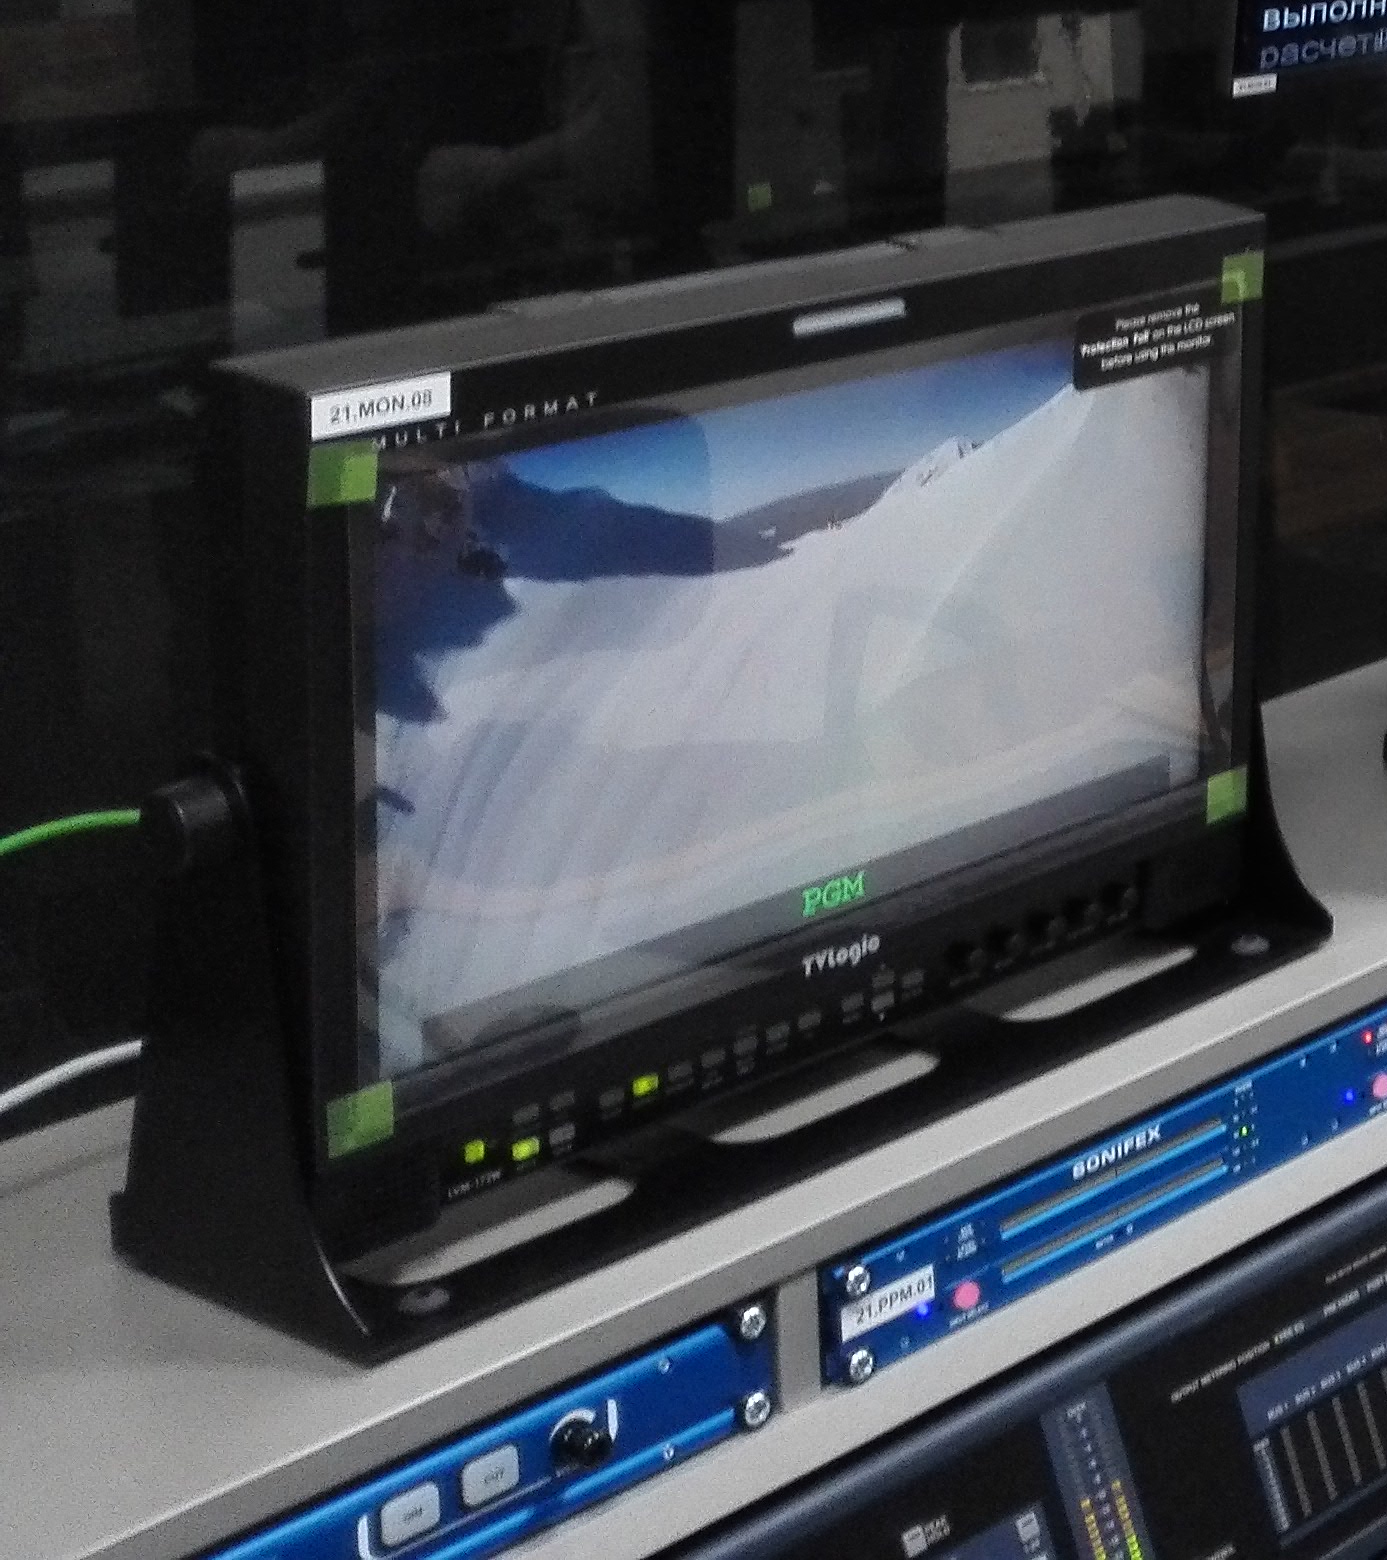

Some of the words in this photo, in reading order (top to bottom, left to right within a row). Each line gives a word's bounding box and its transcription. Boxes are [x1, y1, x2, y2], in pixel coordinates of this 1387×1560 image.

[484, 391, 598, 430] FORMAT
[802, 869, 866, 918] PGM
[1071, 1127, 1162, 1181] SONIFEX
[854, 1273, 933, 1325] 21.PPM.01
